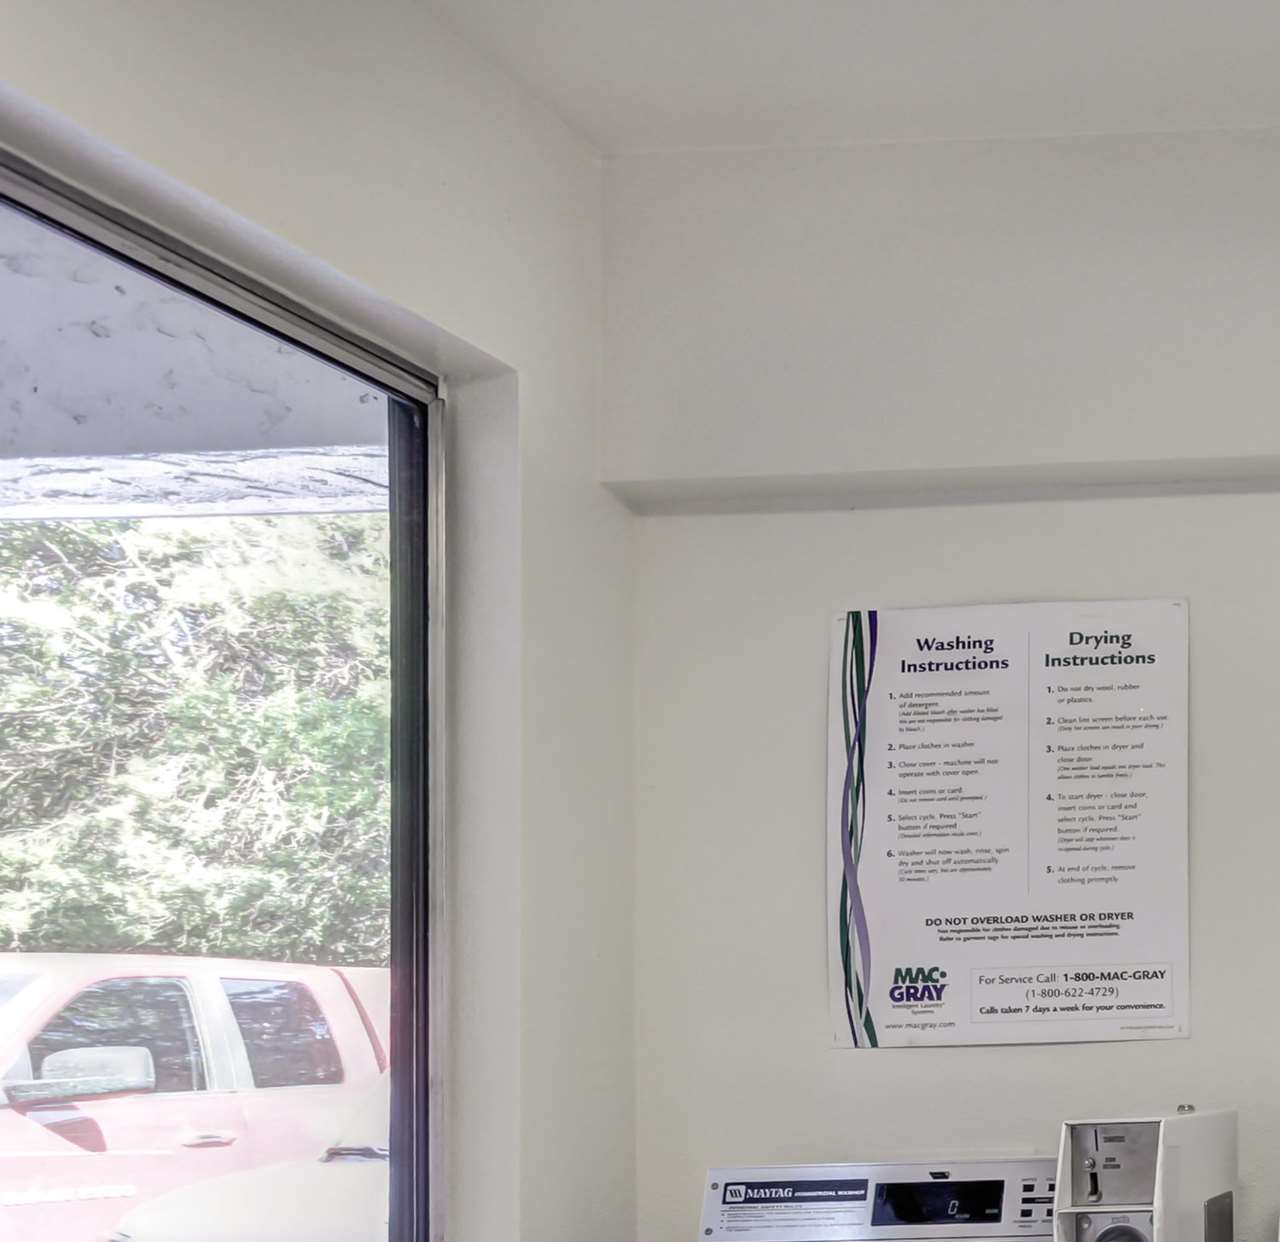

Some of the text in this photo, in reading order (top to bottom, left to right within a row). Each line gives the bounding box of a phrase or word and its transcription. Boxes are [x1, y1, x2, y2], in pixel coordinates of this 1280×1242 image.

[916, 635, 994, 653] Washing
[1069, 630, 1132, 649] Drying
[901, 656, 1009, 673] Instructions
[1045, 651, 1156, 667] Instructions
[1046, 745, 1055, 753] 3.
[1111, 743, 1128, 751] dryer
[925, 912, 1134, 926] DO NOT OVERLOAD WASHER OR DRYER
[978, 975, 995, 985] For
[998, 974, 1033, 984] Service
[1063, 970, 1166, 982] 1-800-MAC-GRAY
[889, 984, 947, 1002] GRAY
[1025, 987, 1119, 1001] (1-800-622-4729)
[979, 1006, 998, 1014] Calls
[1000, 1005, 1022, 1014] taken
[1024, 1005, 1030, 1013] 7
[1032, 1004, 1051, 1014] days
[1060, 1003, 1080, 1012] week
[1082, 1003, 1094, 1011] for
[1096, 1004, 1114, 1013] your
[1116, 1002, 1166, 1011] convenience.
[746, 1188, 793, 1199] MAYTAG
